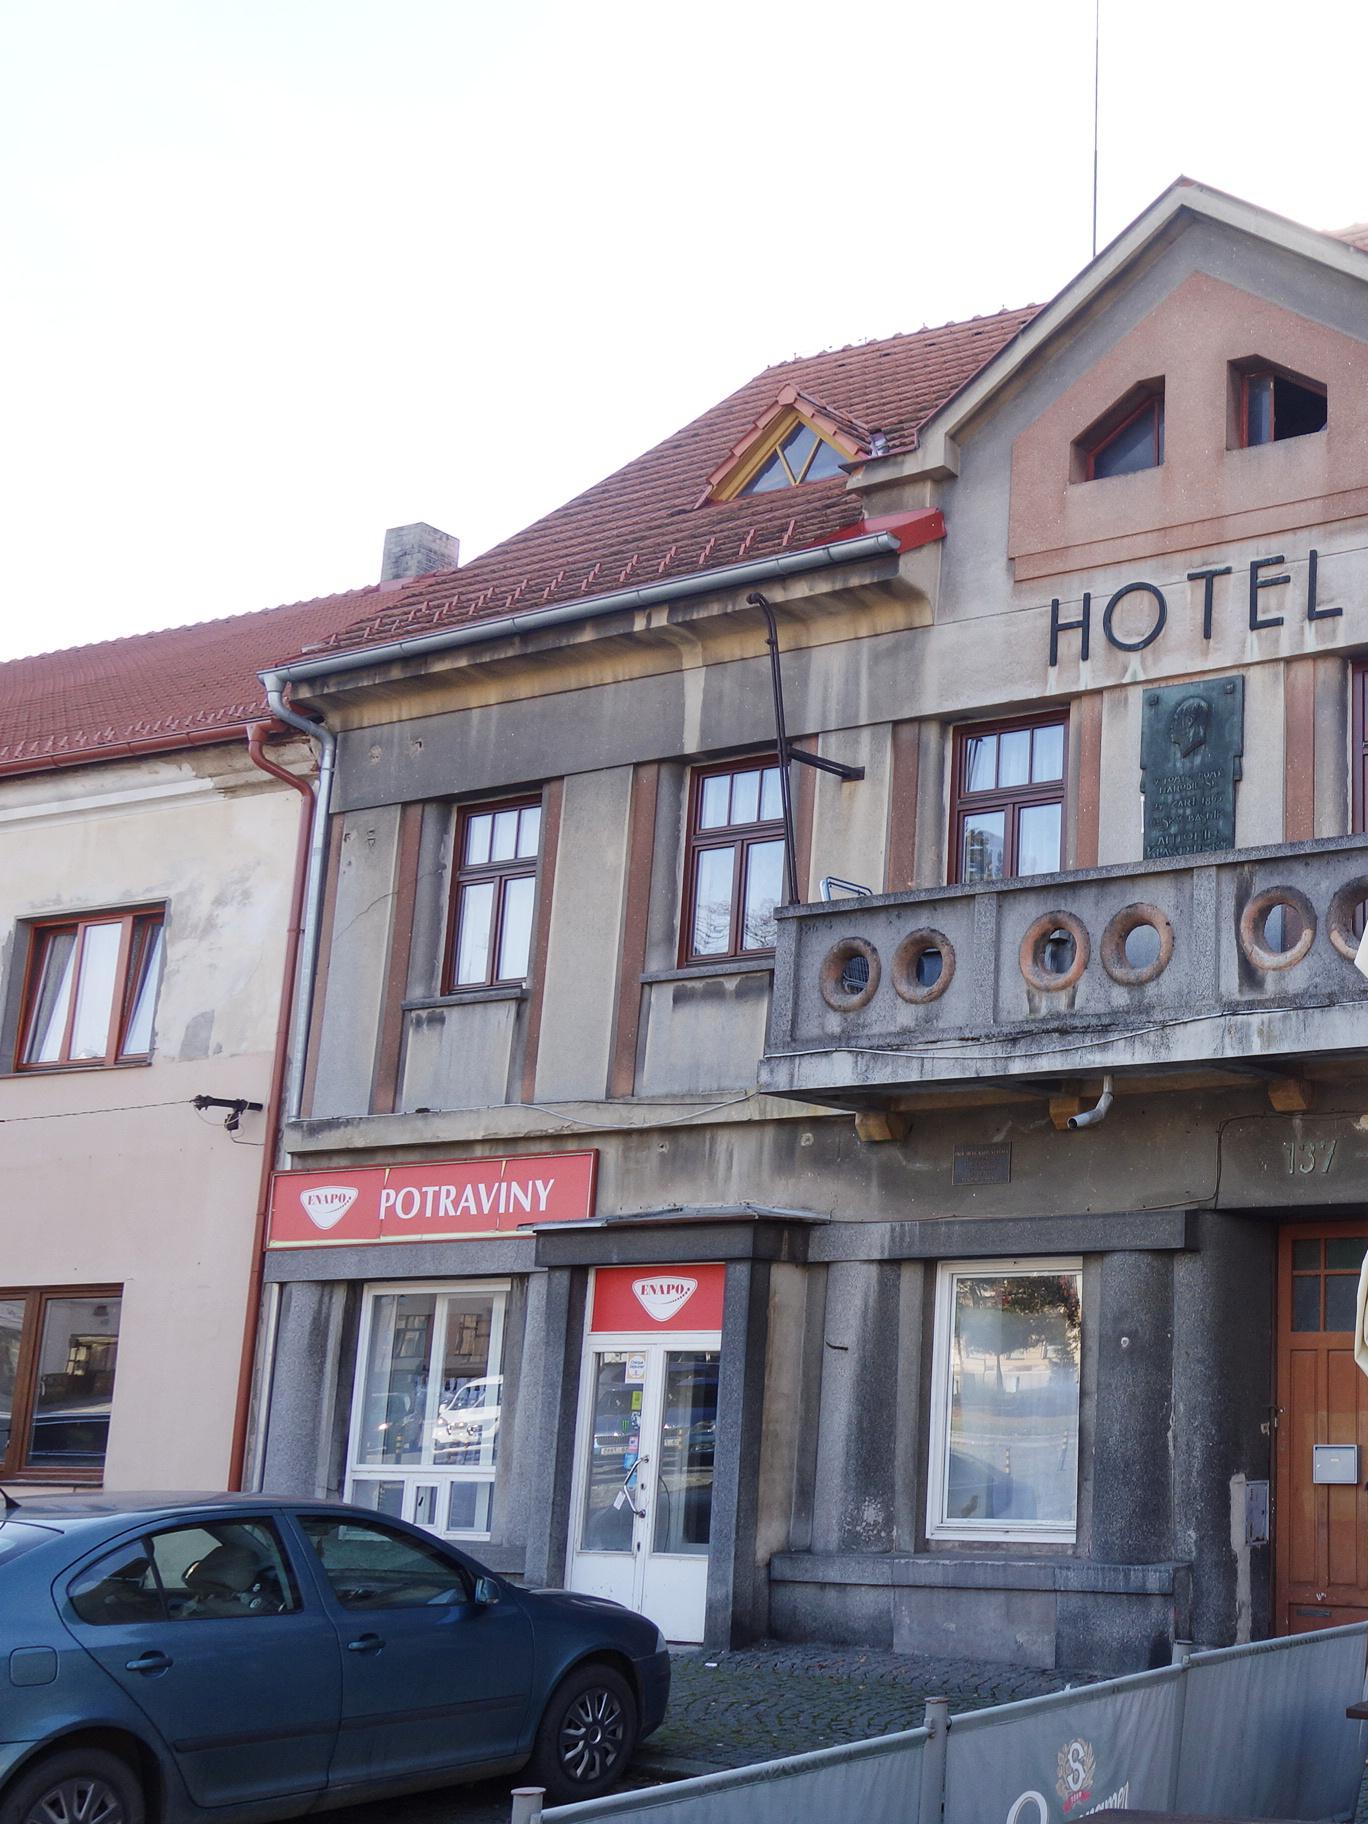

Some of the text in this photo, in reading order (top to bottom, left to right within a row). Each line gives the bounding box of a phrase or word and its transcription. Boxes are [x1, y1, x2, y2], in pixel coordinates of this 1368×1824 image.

[1050, 550, 1343, 666] HOTEL
[1286, 1140, 1337, 1174] 137
[307, 1192, 347, 1206] ENAPO
[379, 1179, 555, 1220] POTRAVINY
[641, 1284, 685, 1296] ENAPO
